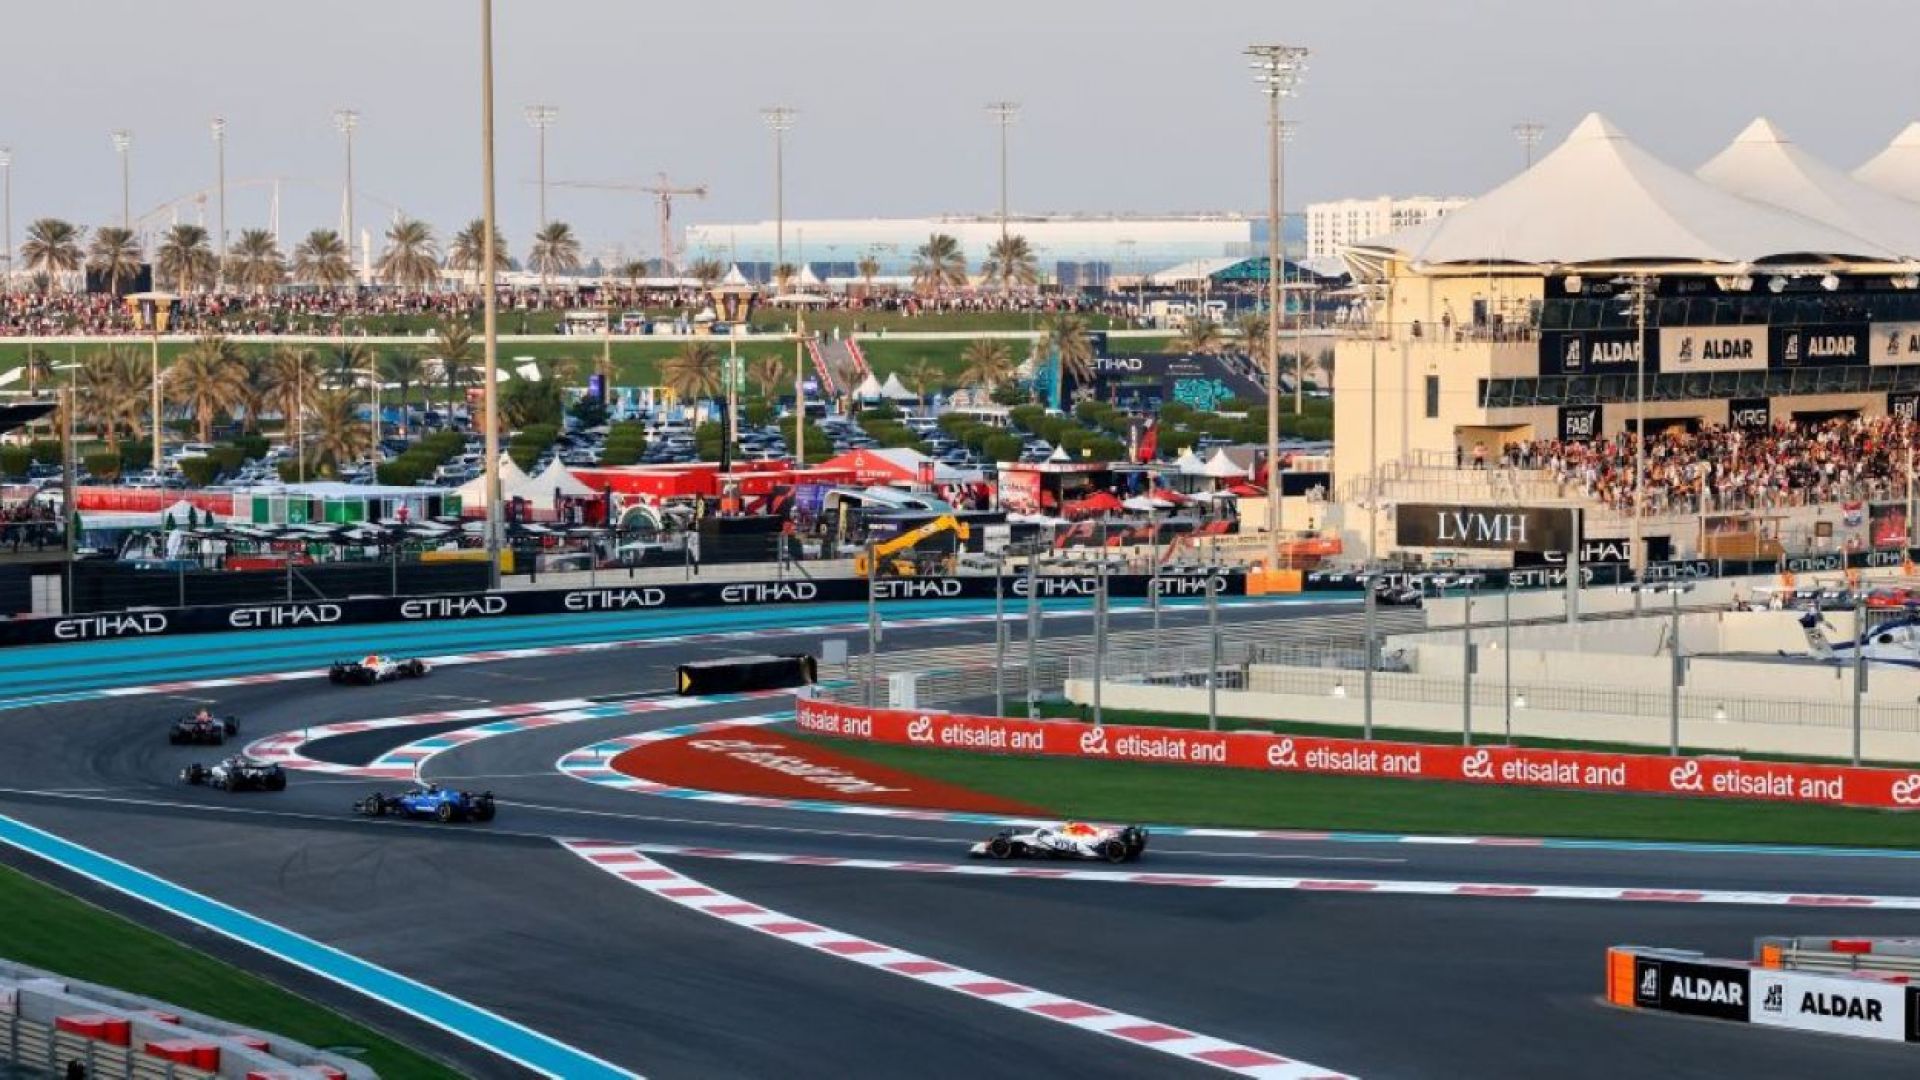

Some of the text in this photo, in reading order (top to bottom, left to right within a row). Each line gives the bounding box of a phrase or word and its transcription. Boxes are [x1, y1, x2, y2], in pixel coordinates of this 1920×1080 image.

[1703, 337, 1753, 360] ALDAR
[1808, 335, 1856, 357] ALDAR
[1437, 511, 1528, 543] LVMH
[564, 588, 666, 611] ETIHAD
[721, 582, 817, 603] ETIHAD
[872, 578, 962, 598] ETIHAD
[229, 604, 342, 627] ETIHAD
[400, 596, 507, 619] ETIHAD
[54, 613, 168, 639] ETIHAD
[843, 714, 873, 737] and
[941, 723, 1006, 747] etisalat
[1010, 727, 1044, 750] and
[1115, 735, 1186, 760] etisalat
[1191, 740, 1226, 763] and
[1305, 747, 1378, 772] etisalat
[1382, 751, 1422, 774] and
[1502, 758, 1580, 784] etisalat
[1585, 762, 1626, 787] and
[1712, 769, 1795, 797] etisalat
[1800, 775, 1843, 800] and
[1670, 975, 1744, 1006] ALDAR
[1801, 990, 1883, 1022] ALDAR
